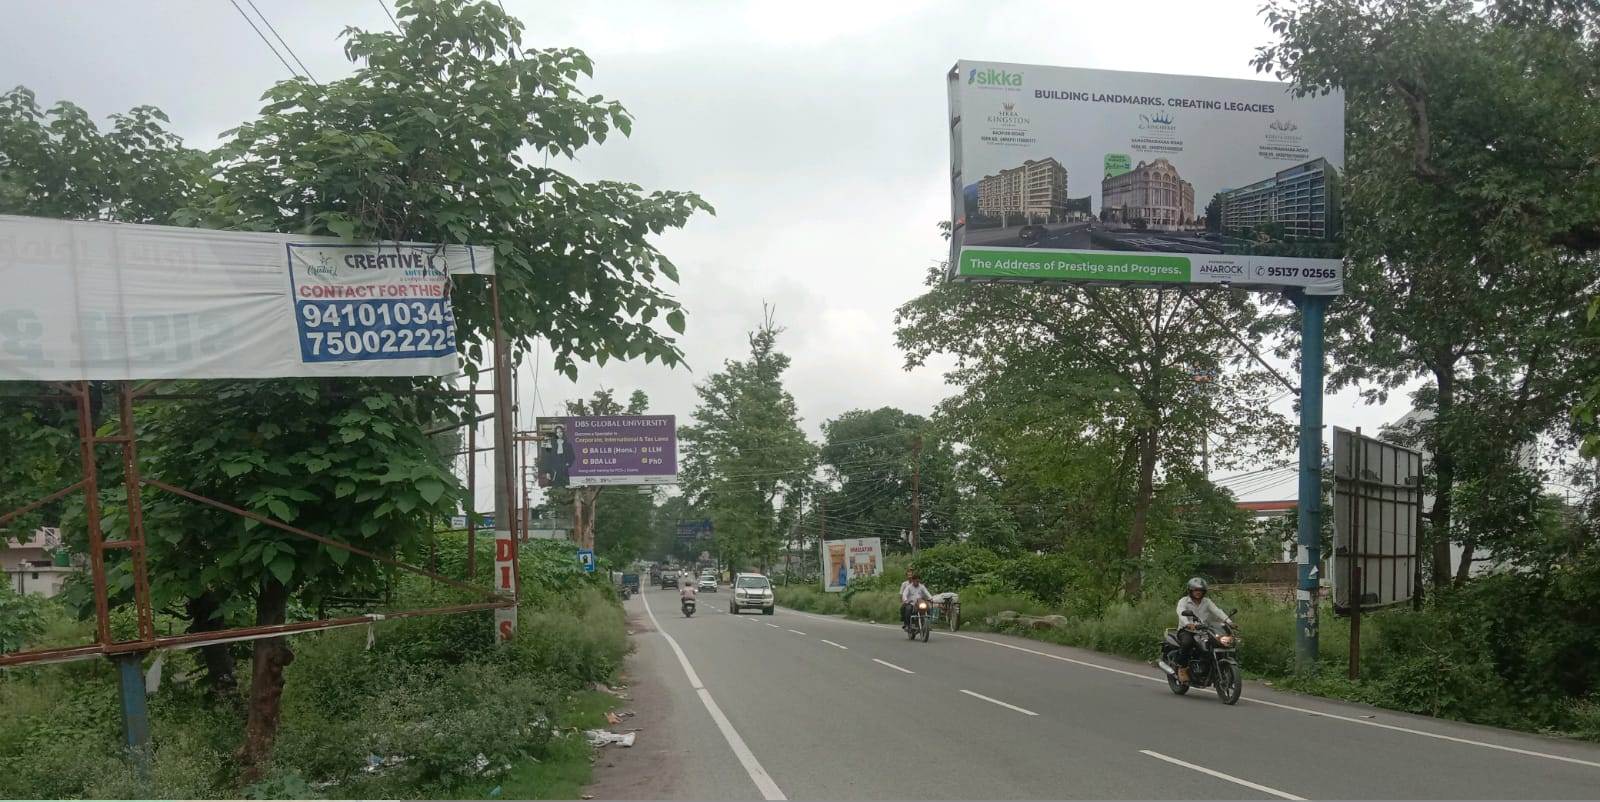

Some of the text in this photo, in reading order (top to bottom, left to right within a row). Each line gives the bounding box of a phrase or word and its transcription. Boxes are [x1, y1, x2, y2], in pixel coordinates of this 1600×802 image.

[977, 68, 1022, 86] sikka
[1034, 89, 1275, 113] BUILDING LANDMARKS. CREATING LEGACIES
[345, 254, 423, 269] CREATIVE
[970, 258, 1182, 277] The Address of Prestige and Progress.
[1199, 265, 1244, 274] ANAROCK
[1267, 266, 1336, 279] 95137 02565
[300, 284, 378, 298] CONTACT
[380, 284, 408, 297] FOR
[409, 284, 442, 297] THIS
[302, 302, 453, 328] 941010345
[575, 420, 589, 428] DBS
[622, 419, 667, 427] UNIVERSITY
